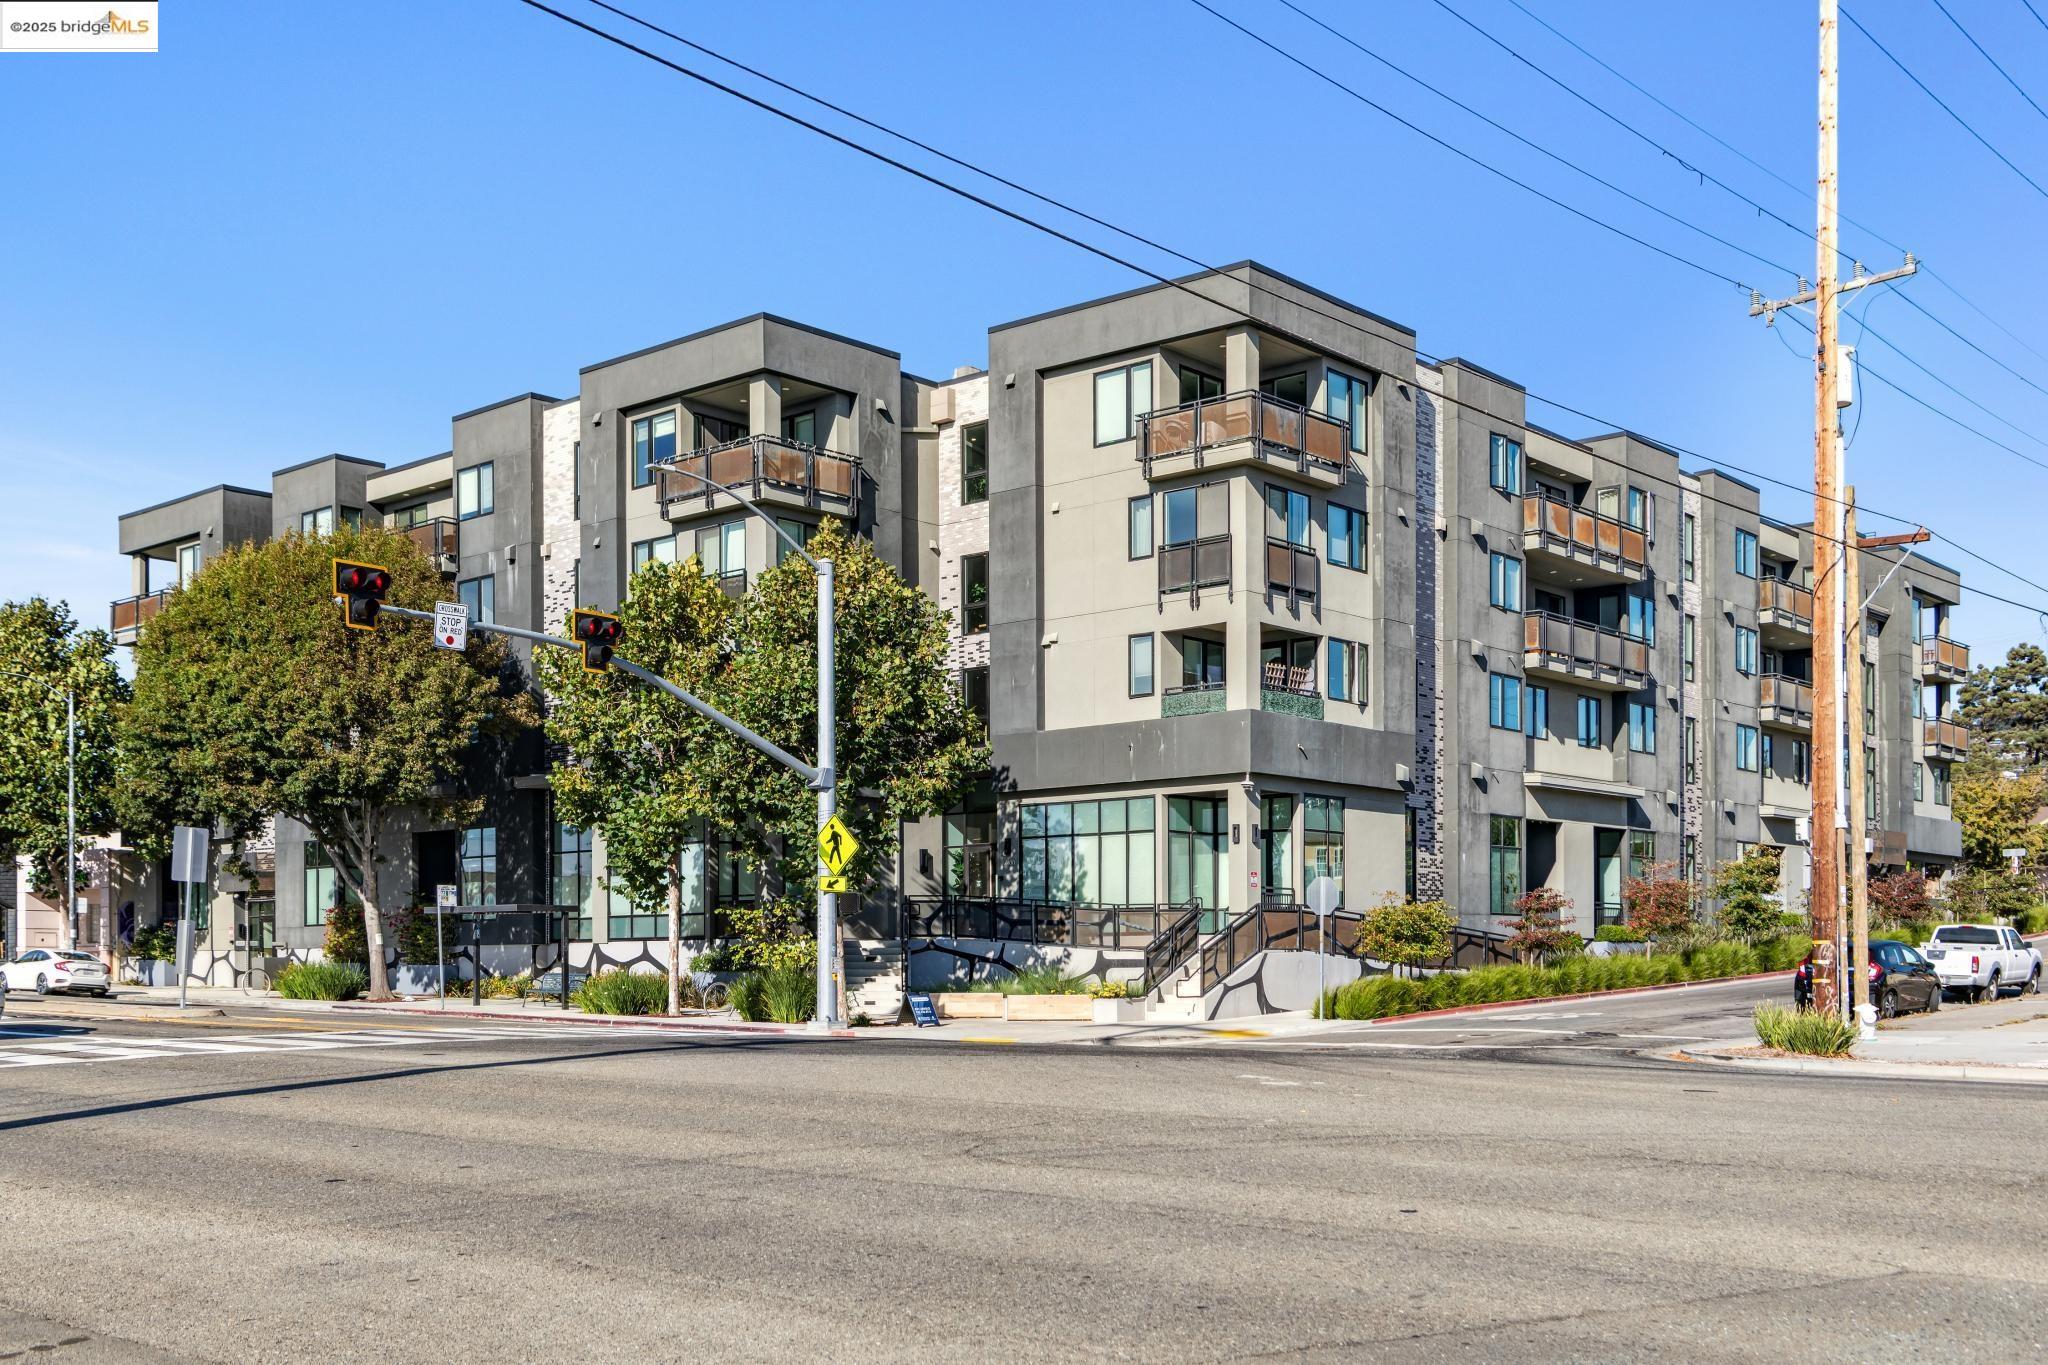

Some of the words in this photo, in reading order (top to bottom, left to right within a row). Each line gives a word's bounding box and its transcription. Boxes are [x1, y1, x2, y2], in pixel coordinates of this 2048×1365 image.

[439, 604, 464, 614] CROSSWALK
[441, 616, 462, 626] STOP
[450, 627, 463, 635] RED
